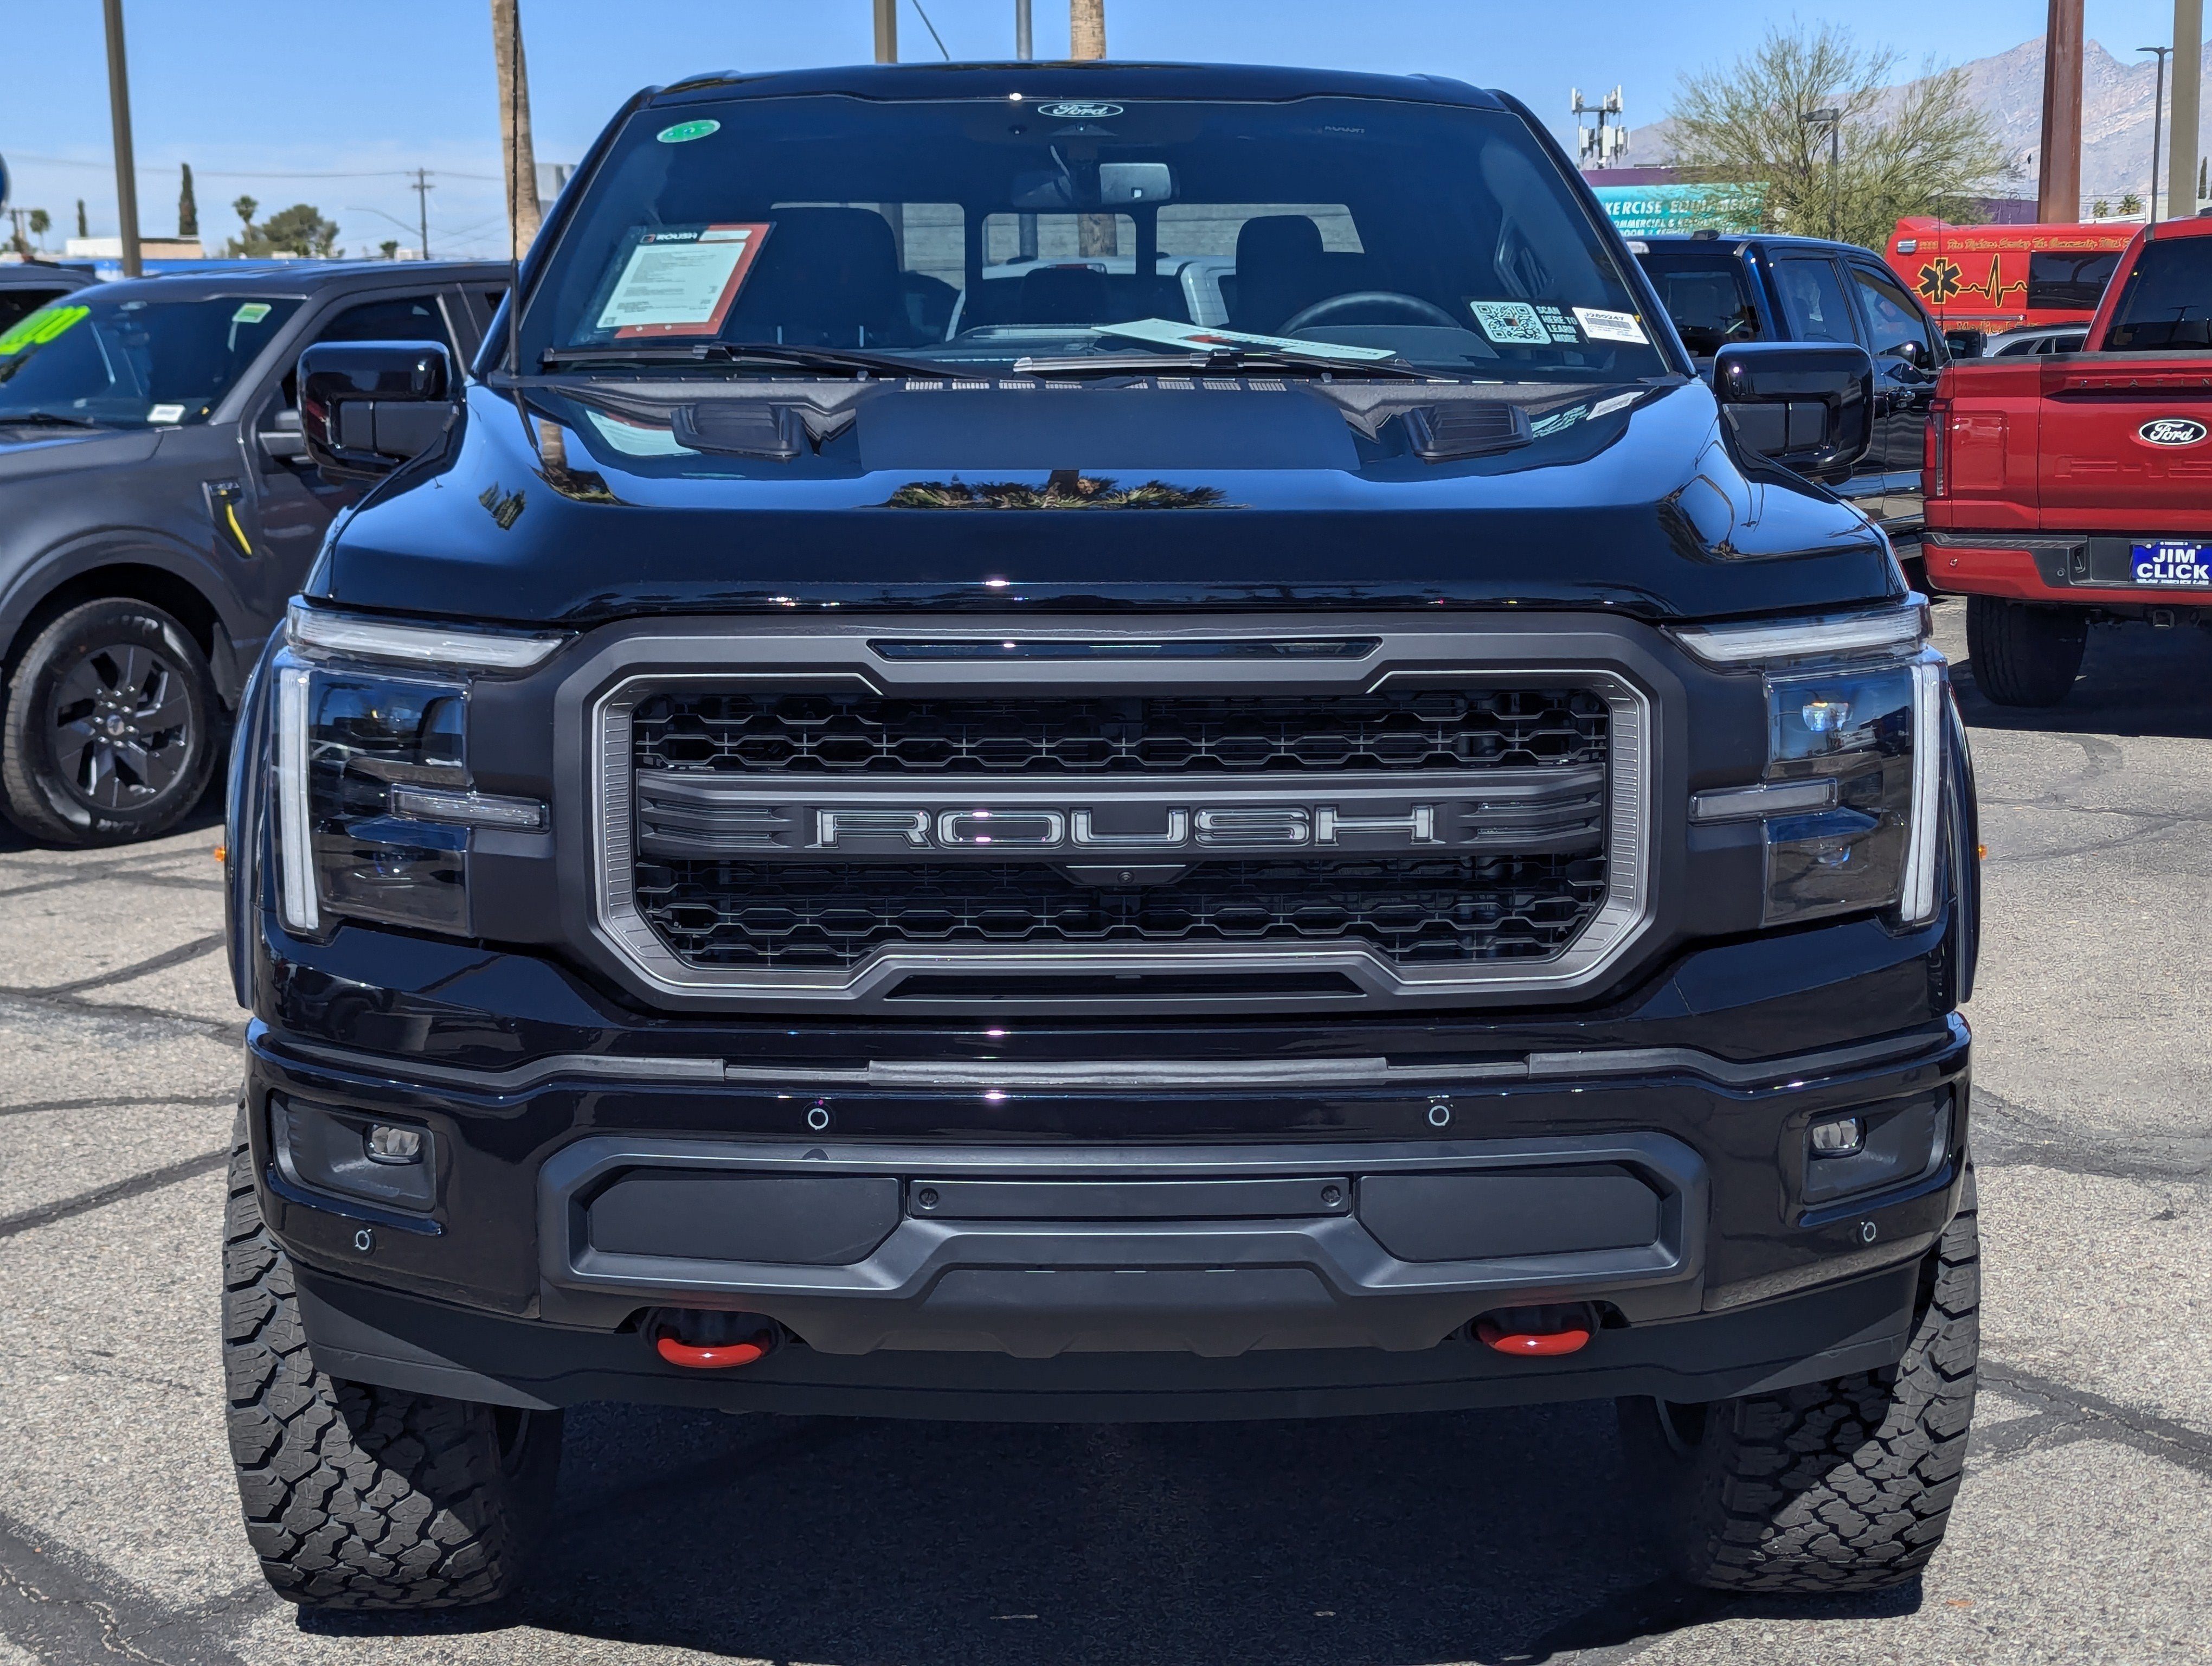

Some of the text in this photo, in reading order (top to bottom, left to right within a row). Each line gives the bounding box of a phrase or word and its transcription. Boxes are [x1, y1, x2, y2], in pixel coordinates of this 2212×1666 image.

[1052, 104, 1109, 116] Ford
[1605, 201, 1662, 215] XERCISE
[1613, 218, 1666, 228] OMMERCIAL
[655, 232, 698, 240] ROUSH
[1535, 305, 1561, 315] SCAN
[1541, 315, 1566, 324] HERE
[1566, 316, 1578, 325] TO
[1546, 324, 1577, 334] LEARN
[1552, 333, 1579, 343] MORE
[2150, 422, 2195, 441] Ford
[2152, 548, 2196, 563] JIM
[2137, 563, 2209, 579] CLICK
[815, 804, 1446, 850] ROUSH
